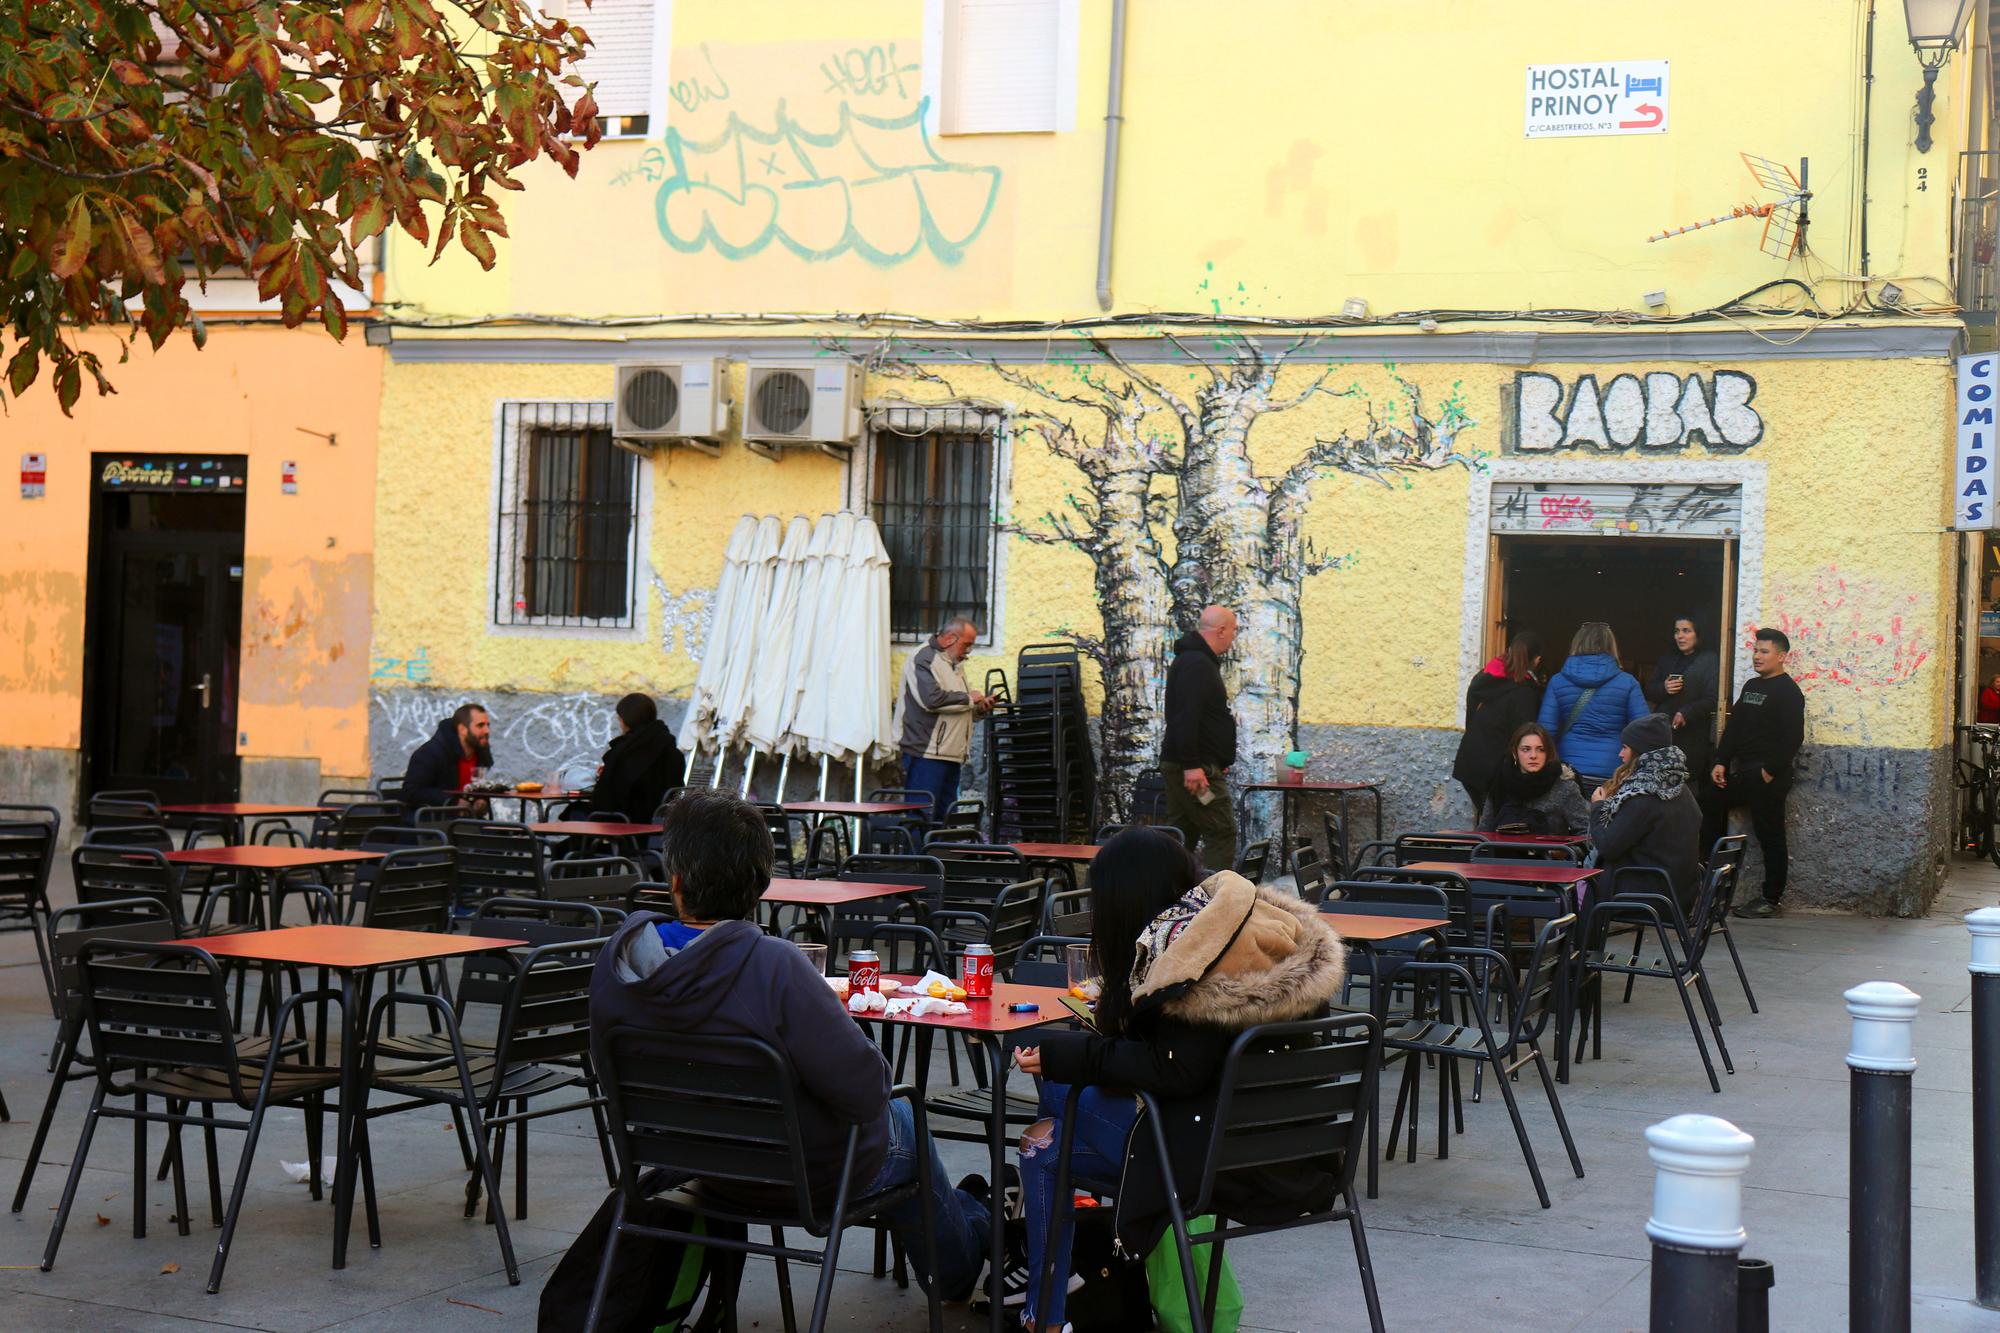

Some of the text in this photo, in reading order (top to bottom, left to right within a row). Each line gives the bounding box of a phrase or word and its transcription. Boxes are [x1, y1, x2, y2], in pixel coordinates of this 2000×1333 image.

[1531, 67, 1620, 91] HOSTAL
[1531, 94, 1618, 117] PRINOY
[1514, 369, 1764, 453] BAOBAB
[1962, 360, 1993, 521] COMIDAS
